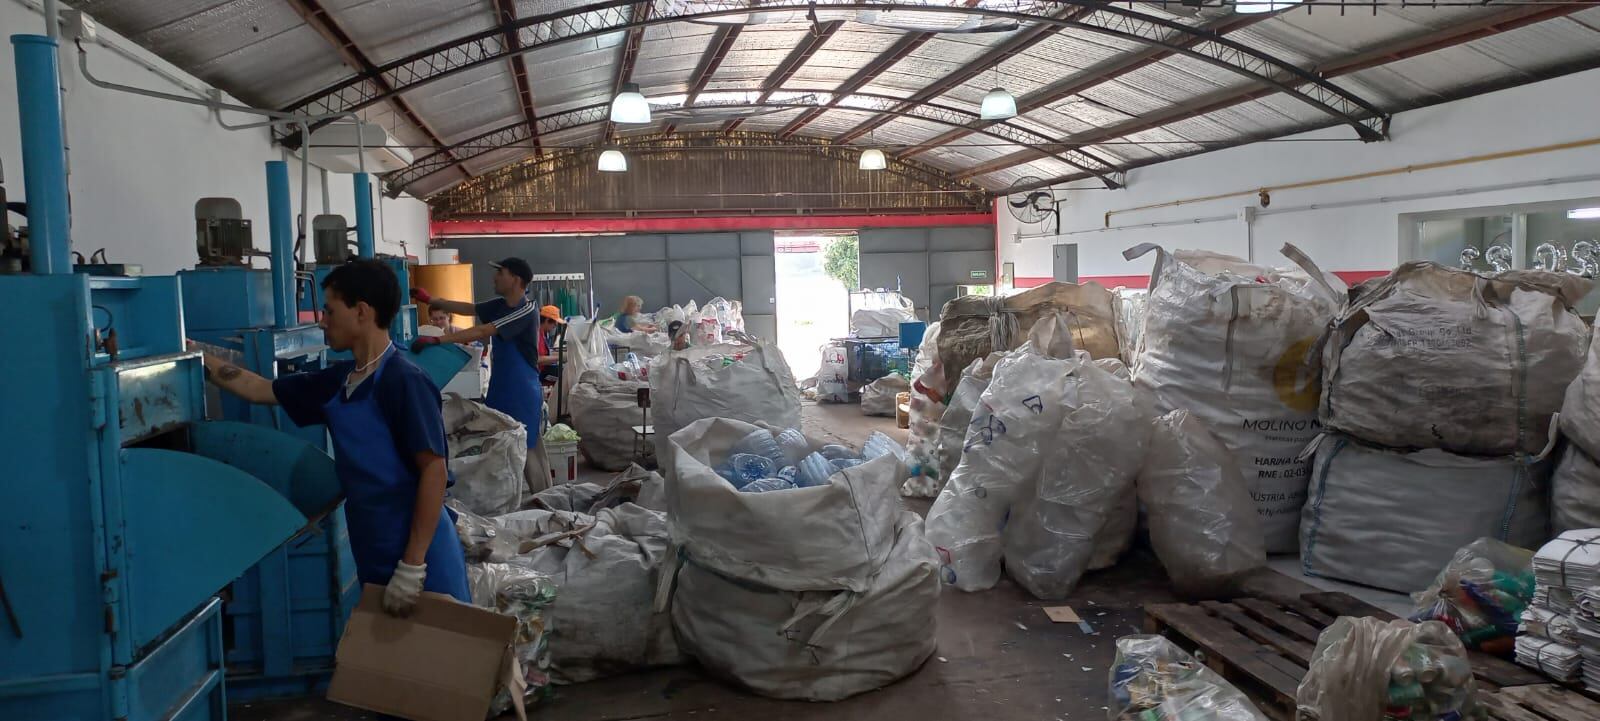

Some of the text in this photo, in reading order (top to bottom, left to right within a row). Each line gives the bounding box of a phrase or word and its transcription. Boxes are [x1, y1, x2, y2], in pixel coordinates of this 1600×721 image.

[1242, 418, 1306, 432] MOLINO
[1255, 457, 1291, 466] HARINA
[1258, 470, 1278, 479] RNE
